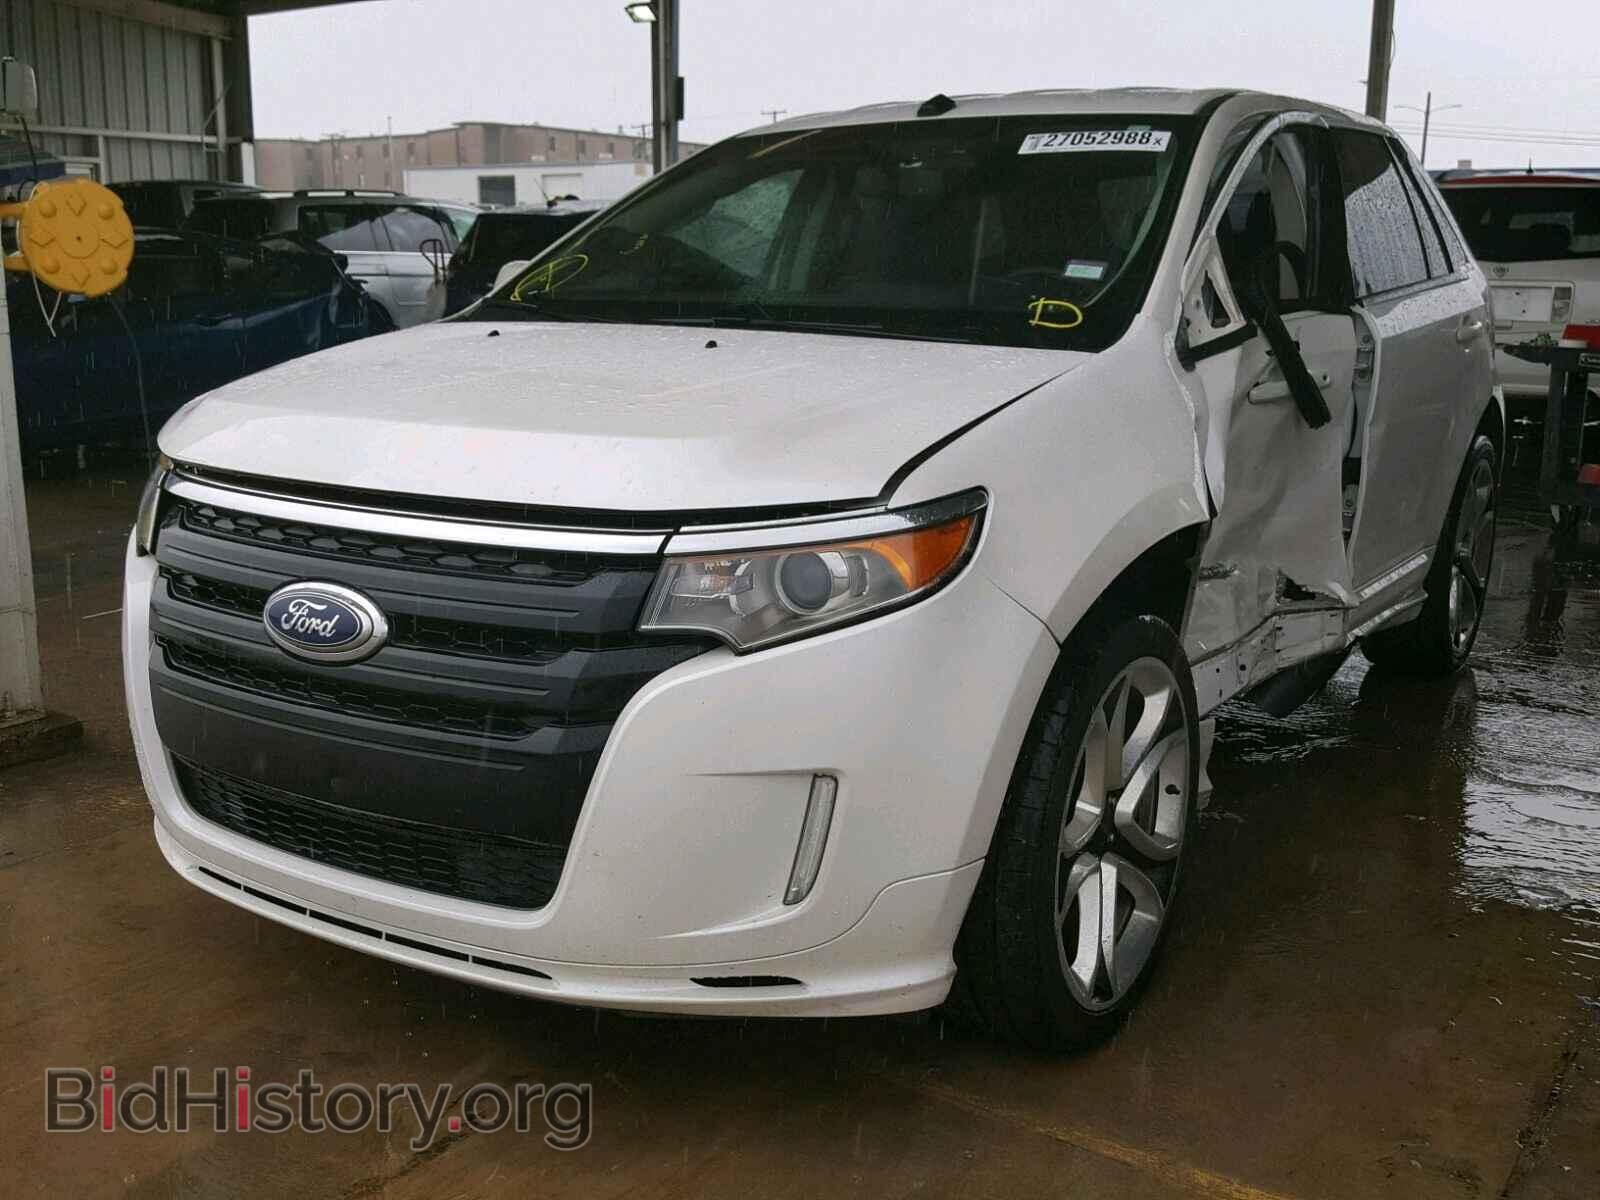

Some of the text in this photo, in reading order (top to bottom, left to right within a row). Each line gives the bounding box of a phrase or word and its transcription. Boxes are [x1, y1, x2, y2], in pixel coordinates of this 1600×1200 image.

[1043, 131, 1153, 147] 27052988
[1028, 297, 1083, 328] D
[281, 599, 340, 638] Ford
